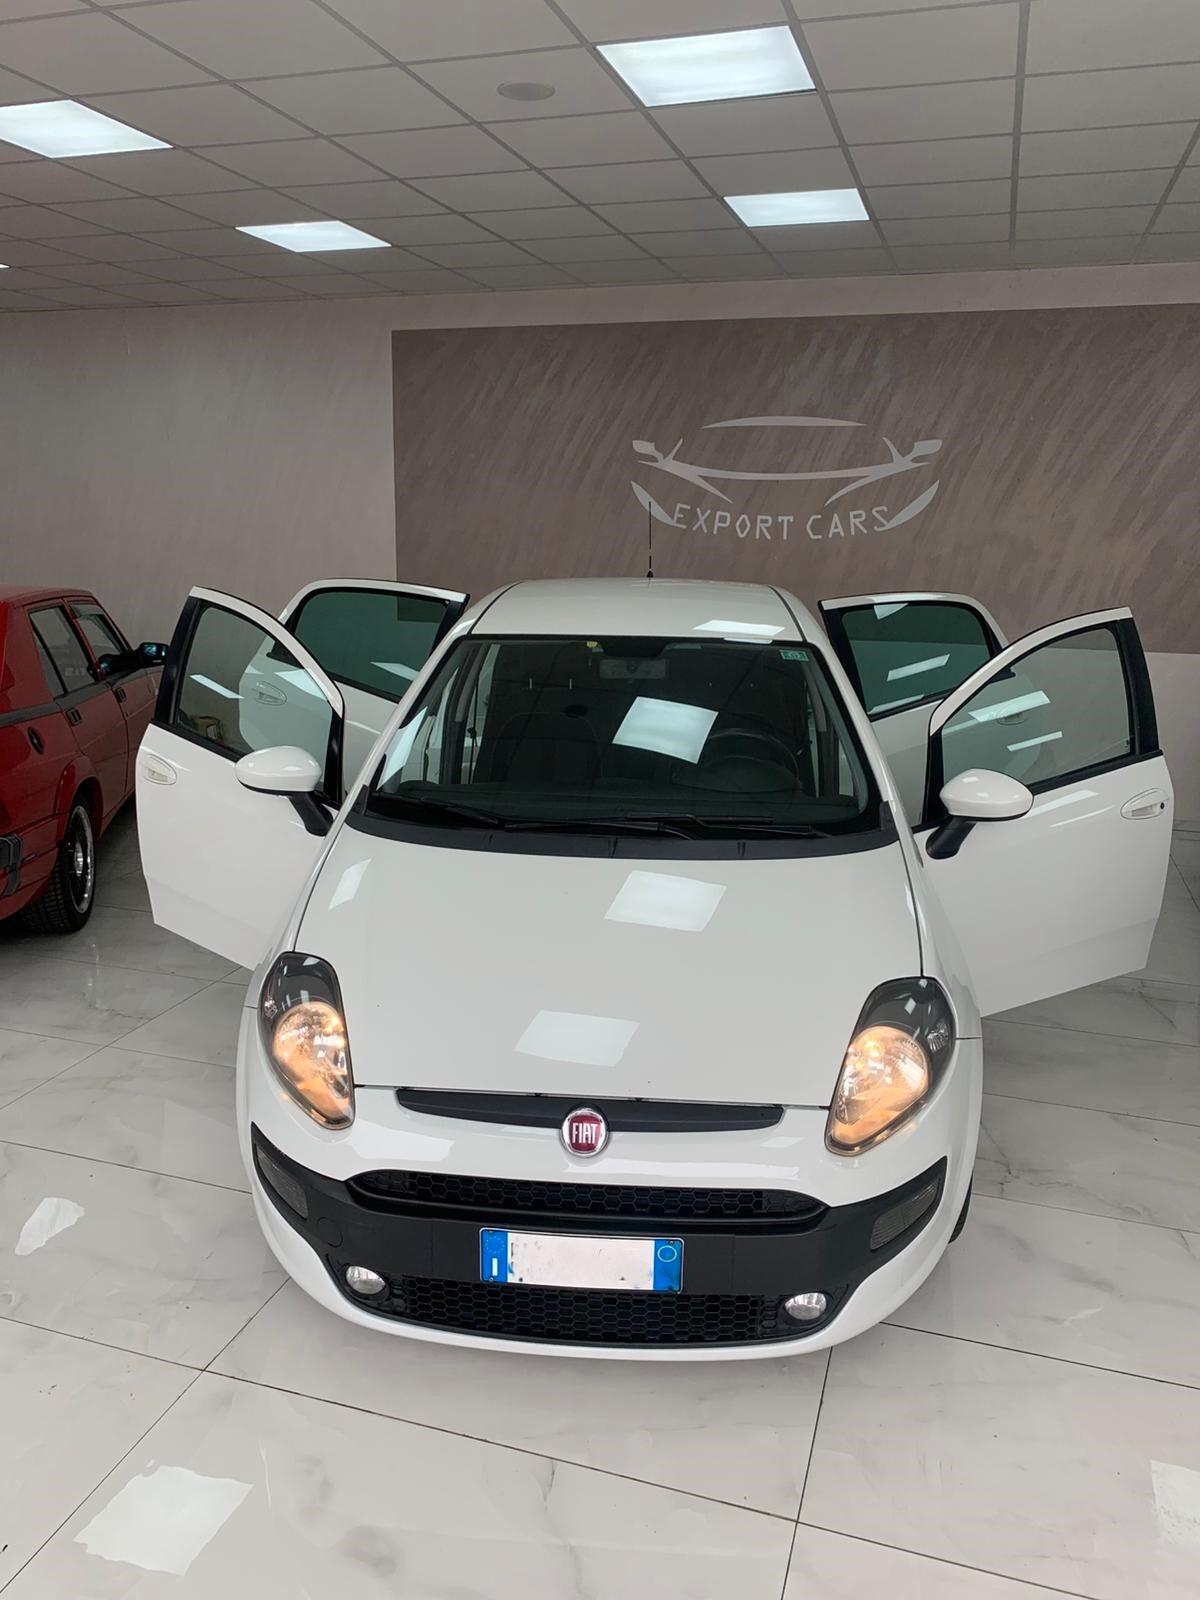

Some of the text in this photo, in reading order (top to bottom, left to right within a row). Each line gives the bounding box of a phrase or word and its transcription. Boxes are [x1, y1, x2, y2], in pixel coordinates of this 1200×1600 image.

[673, 503, 892, 540] EXPORT CARS
[572, 1122, 598, 1144] FIAT
